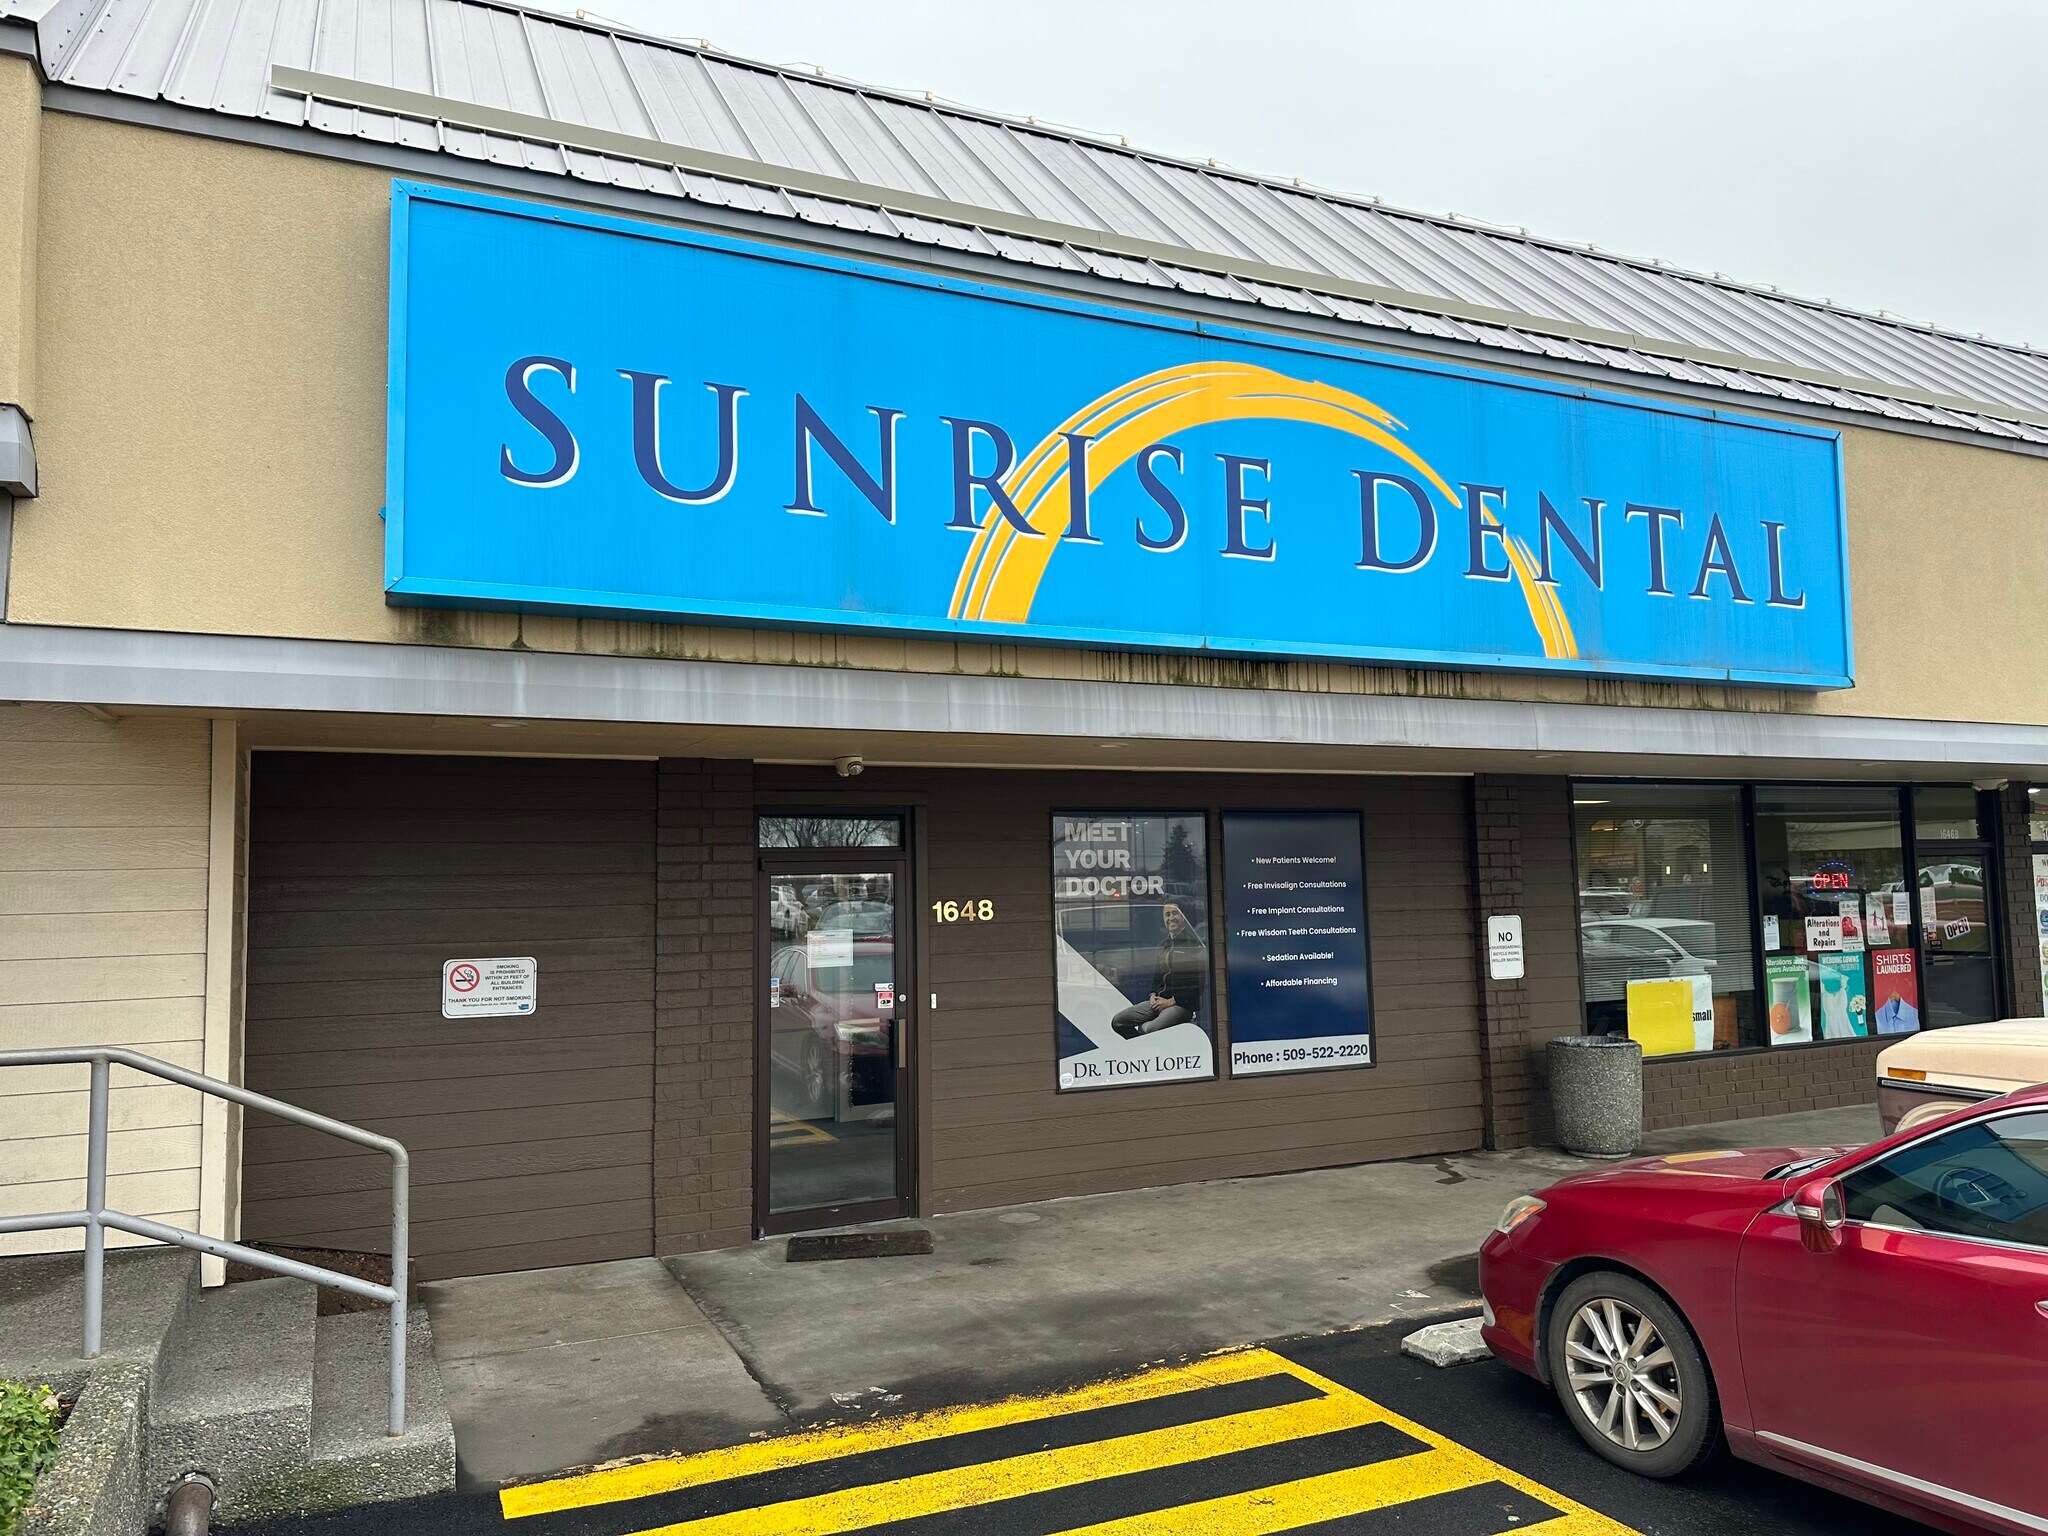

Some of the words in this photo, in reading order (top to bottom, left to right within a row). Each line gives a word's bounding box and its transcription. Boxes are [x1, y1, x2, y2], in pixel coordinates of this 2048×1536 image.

[500, 355, 1276, 562] SUNRISE
[1349, 469, 1805, 610] DENTAL
[1064, 823, 1131, 841] MEET
[1065, 850, 1130, 868] YOUR
[1272, 856, 1300, 864] Patients
[1302, 856, 1336, 864] Welcome!
[1066, 876, 1164, 896] DOCTOR
[1264, 881, 1298, 890] Invisalign
[1299, 880, 1346, 888] Consultations
[1813, 874, 1848, 888] OPEN
[932, 900, 994, 922] 1648
[1268, 906, 1296, 916] Implant
[1297, 905, 1344, 913] Consultations
[1807, 918, 1839, 928] Alterations
[1946, 918, 1968, 938] OPEN
[1258, 928, 1287, 936] Wisdom
[1309, 926, 1356, 934] Consultations
[1819, 928, 1829, 936] and
[1498, 932, 1512, 942] NO
[1813, 938, 1836, 948] Repairs
[1266, 953, 1298, 962] Sedation
[1300, 952, 1334, 960] Available!
[1876, 954, 1911, 965] SHIRTS
[1876, 964, 1911, 974] LAUNDERED
[1266, 978, 1302, 987] Affordable
[1304, 977, 1337, 986] Financing
[1693, 1010, 1711, 1021] small
[1234, 1052, 1273, 1065] Phone
[1283, 1044, 1368, 1060] 509-522-2220
[1074, 1062, 1101, 1078] DR.
[1105, 1060, 1150, 1075] TONY
[1156, 1056, 1201, 1072] LOPEZ
